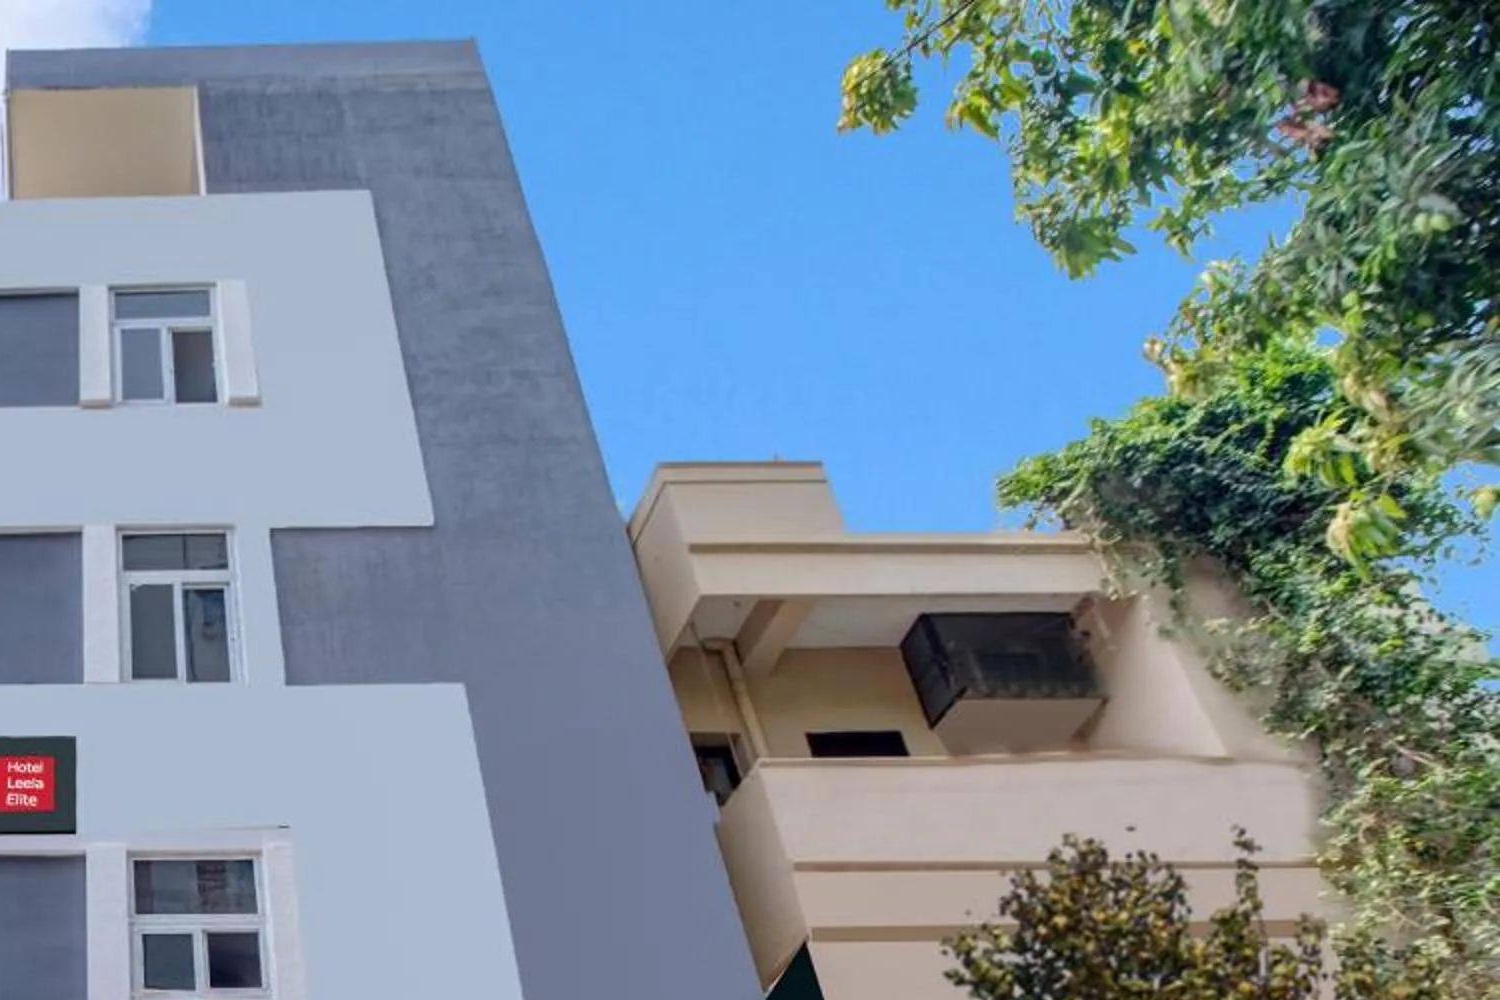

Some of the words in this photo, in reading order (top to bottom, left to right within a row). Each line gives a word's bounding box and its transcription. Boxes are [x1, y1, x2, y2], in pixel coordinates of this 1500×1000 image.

[7, 761, 44, 774] Hotel
[7, 777, 45, 790] Leela
[6, 793, 38, 807] Elite
